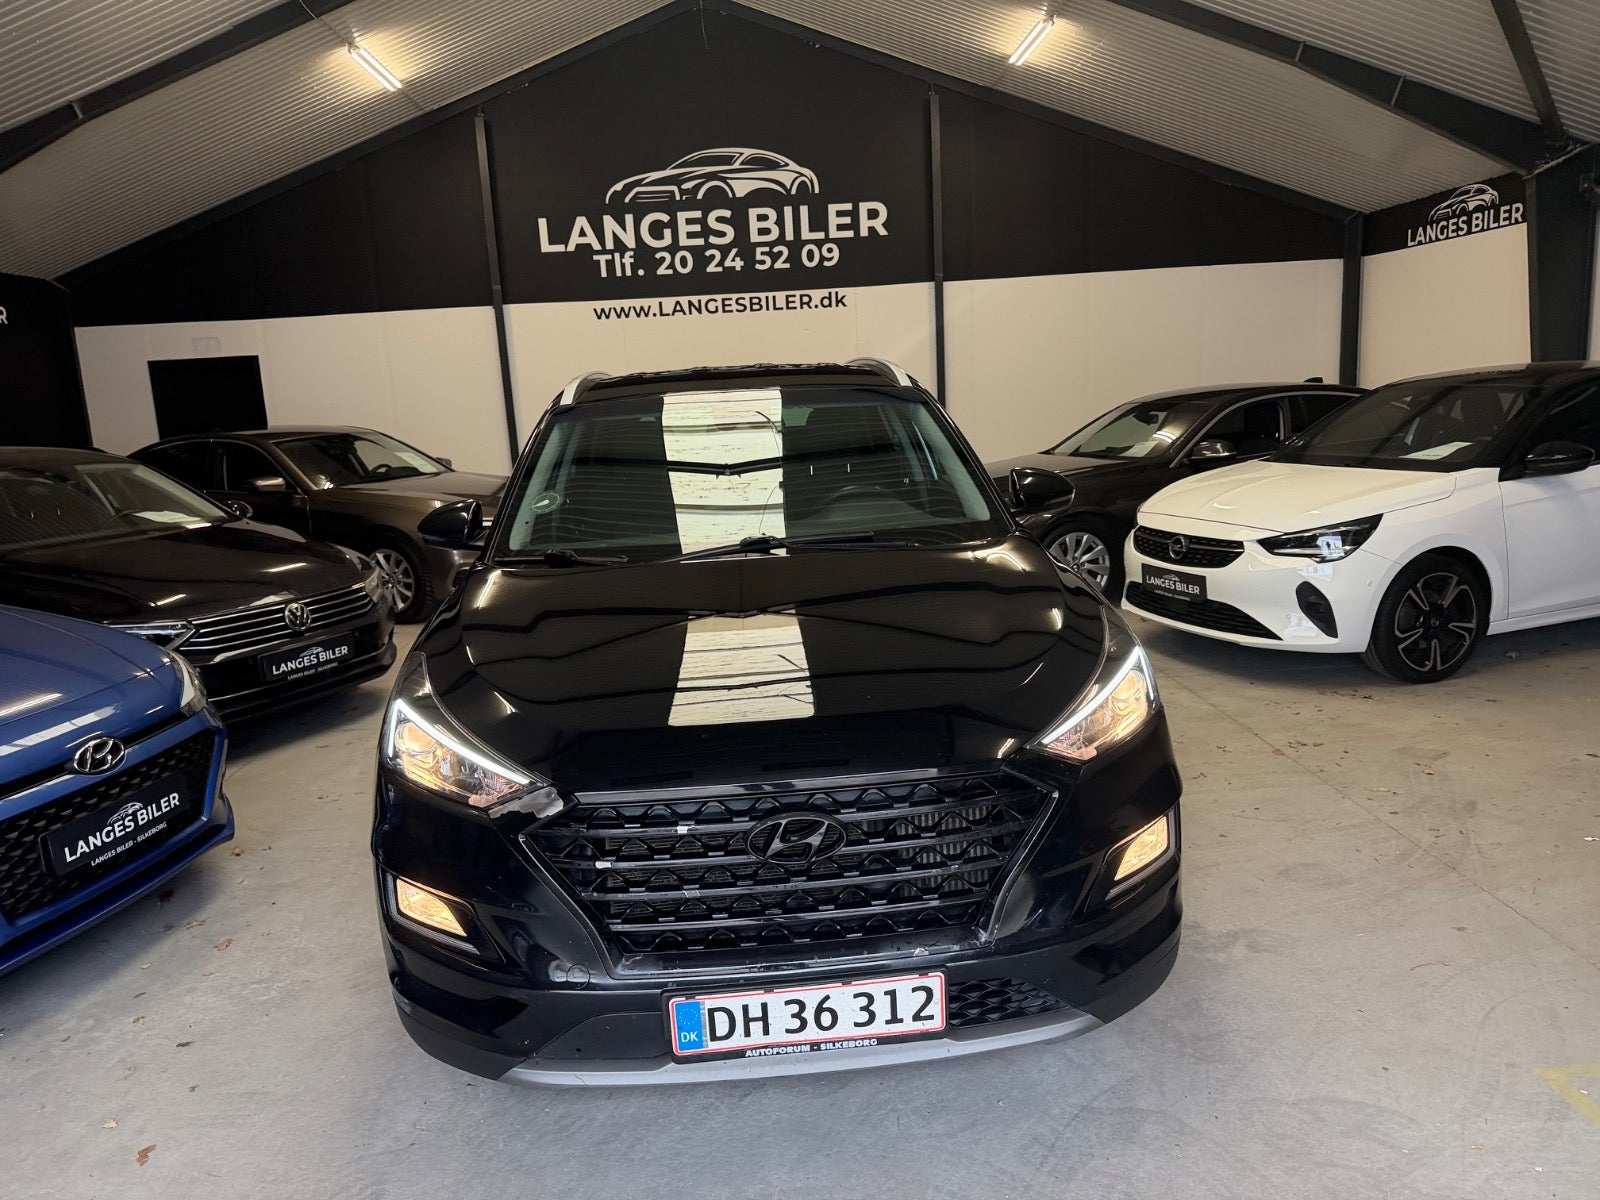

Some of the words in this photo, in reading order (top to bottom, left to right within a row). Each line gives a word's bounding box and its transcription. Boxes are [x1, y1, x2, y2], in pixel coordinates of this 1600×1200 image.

[537, 208, 736, 253] LANGES
[748, 201, 889, 243] BILER
[1407, 215, 1467, 246] LANGES
[1471, 202, 1524, 233] BILER
[592, 250, 645, 278] Tlf.
[655, 250, 694, 275] 20
[704, 248, 745, 273] 24
[754, 245, 791, 270] 52
[801, 242, 840, 268] 09
[593, 291, 848, 320] www.LANGESBILER.dk
[1146, 575, 1175, 590] LANGES
[1175, 582, 1200, 595] BILER
[272, 654, 318, 675] LANGES
[319, 645, 349, 662] BILER
[64, 815, 135, 863] LANGES
[136, 792, 180, 826] BILER
[91, 849, 116, 866] LANGES
[116, 840, 134, 854] BILER
[137, 821, 168, 843] SILKEBORG
[707, 1001, 771, 1042] DH
[784, 994, 839, 1034] 36
[852, 985, 935, 1028] 312
[680, 1030, 699, 1044] DK
[745, 1043, 811, 1058] AUTOFORUM
[820, 1038, 878, 1051] SILKEBORG
